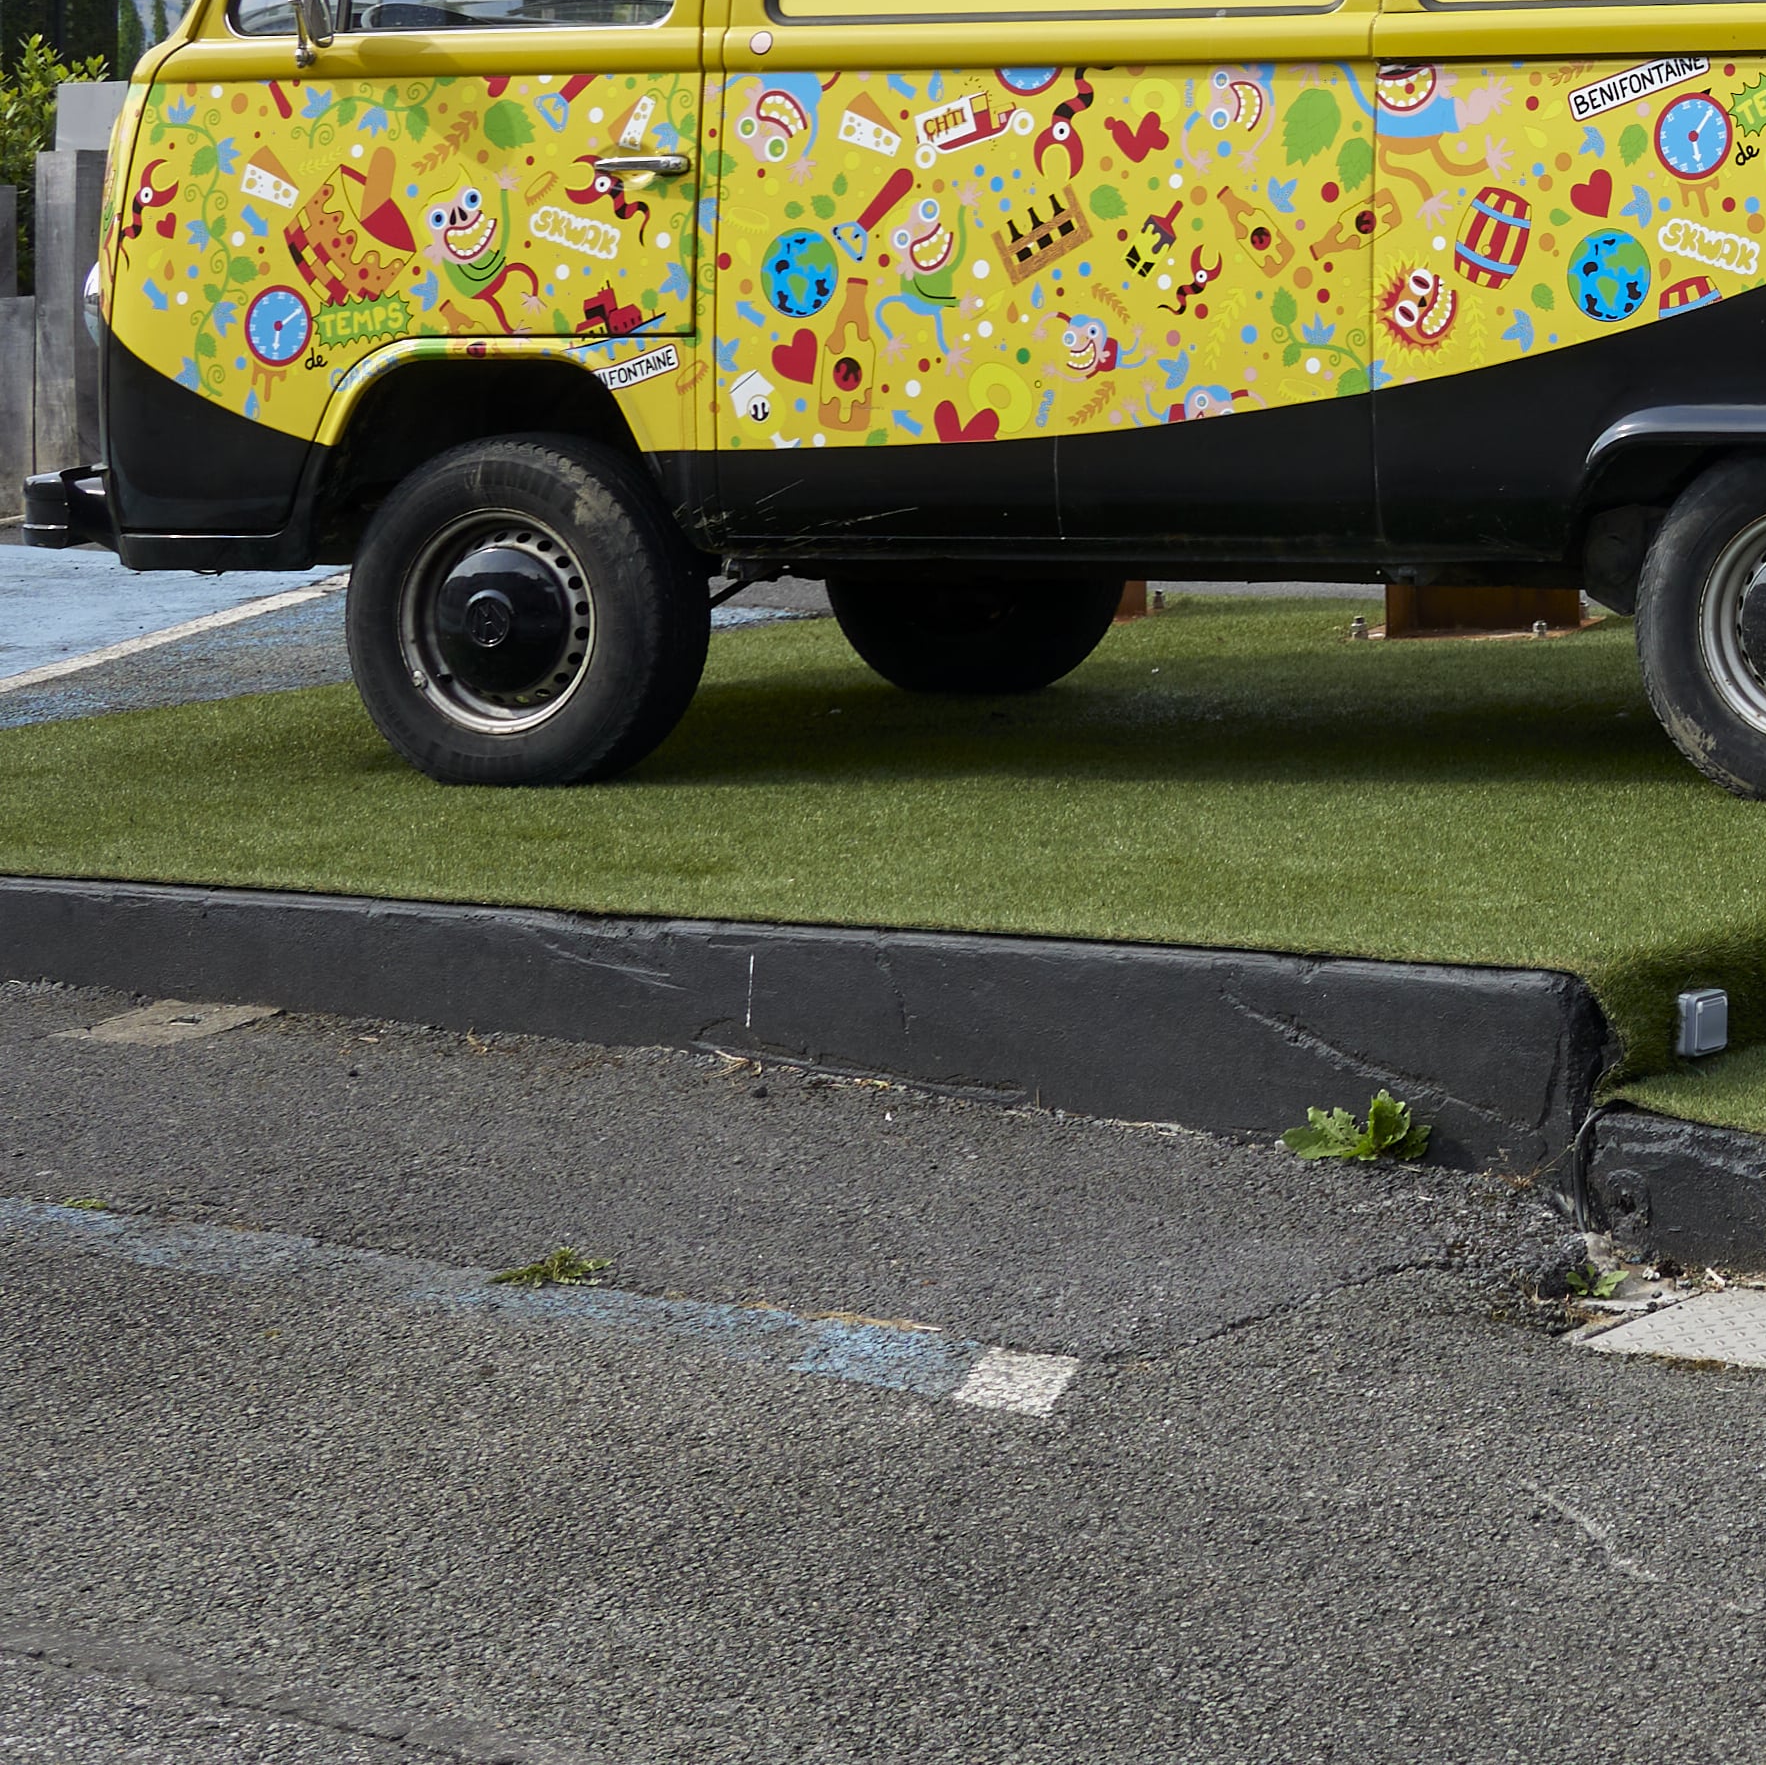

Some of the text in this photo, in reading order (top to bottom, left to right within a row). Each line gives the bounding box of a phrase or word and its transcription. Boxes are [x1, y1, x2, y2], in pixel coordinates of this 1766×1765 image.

[1573, 57, 1706, 116] BENIFONTAINE
[1735, 141, 1760, 166] de
[319, 301, 405, 338] TEMPS
[304, 347, 328, 370] de
[598, 349, 676, 385] IFONTAINE
